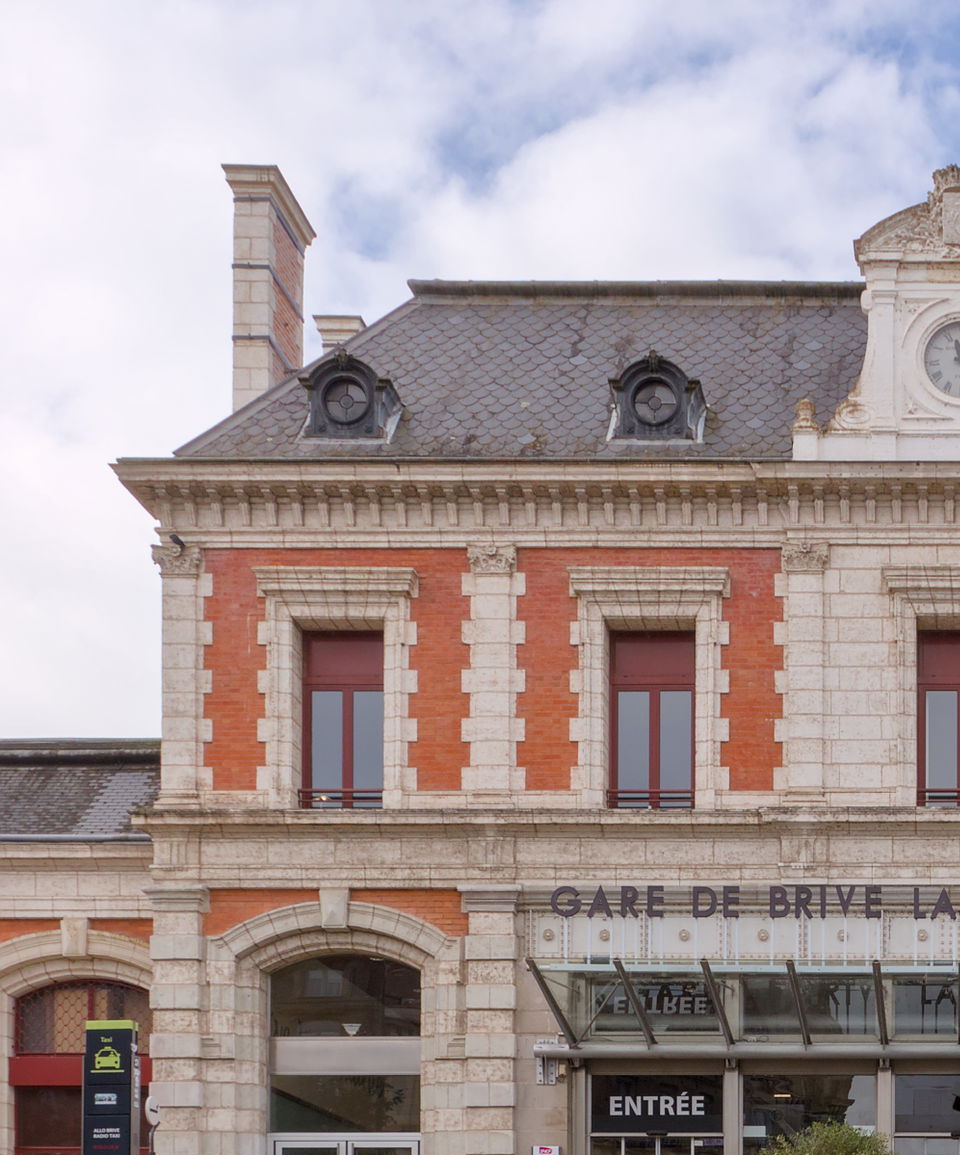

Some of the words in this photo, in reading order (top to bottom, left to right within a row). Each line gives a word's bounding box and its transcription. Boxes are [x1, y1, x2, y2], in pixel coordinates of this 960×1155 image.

[550, 885, 665, 919] GARE
[692, 886, 740, 919] DE
[769, 886, 883, 919] BRIVE
[913, 887, 957, 919] LA
[609, 1090, 705, 1117] ENTRÉE
